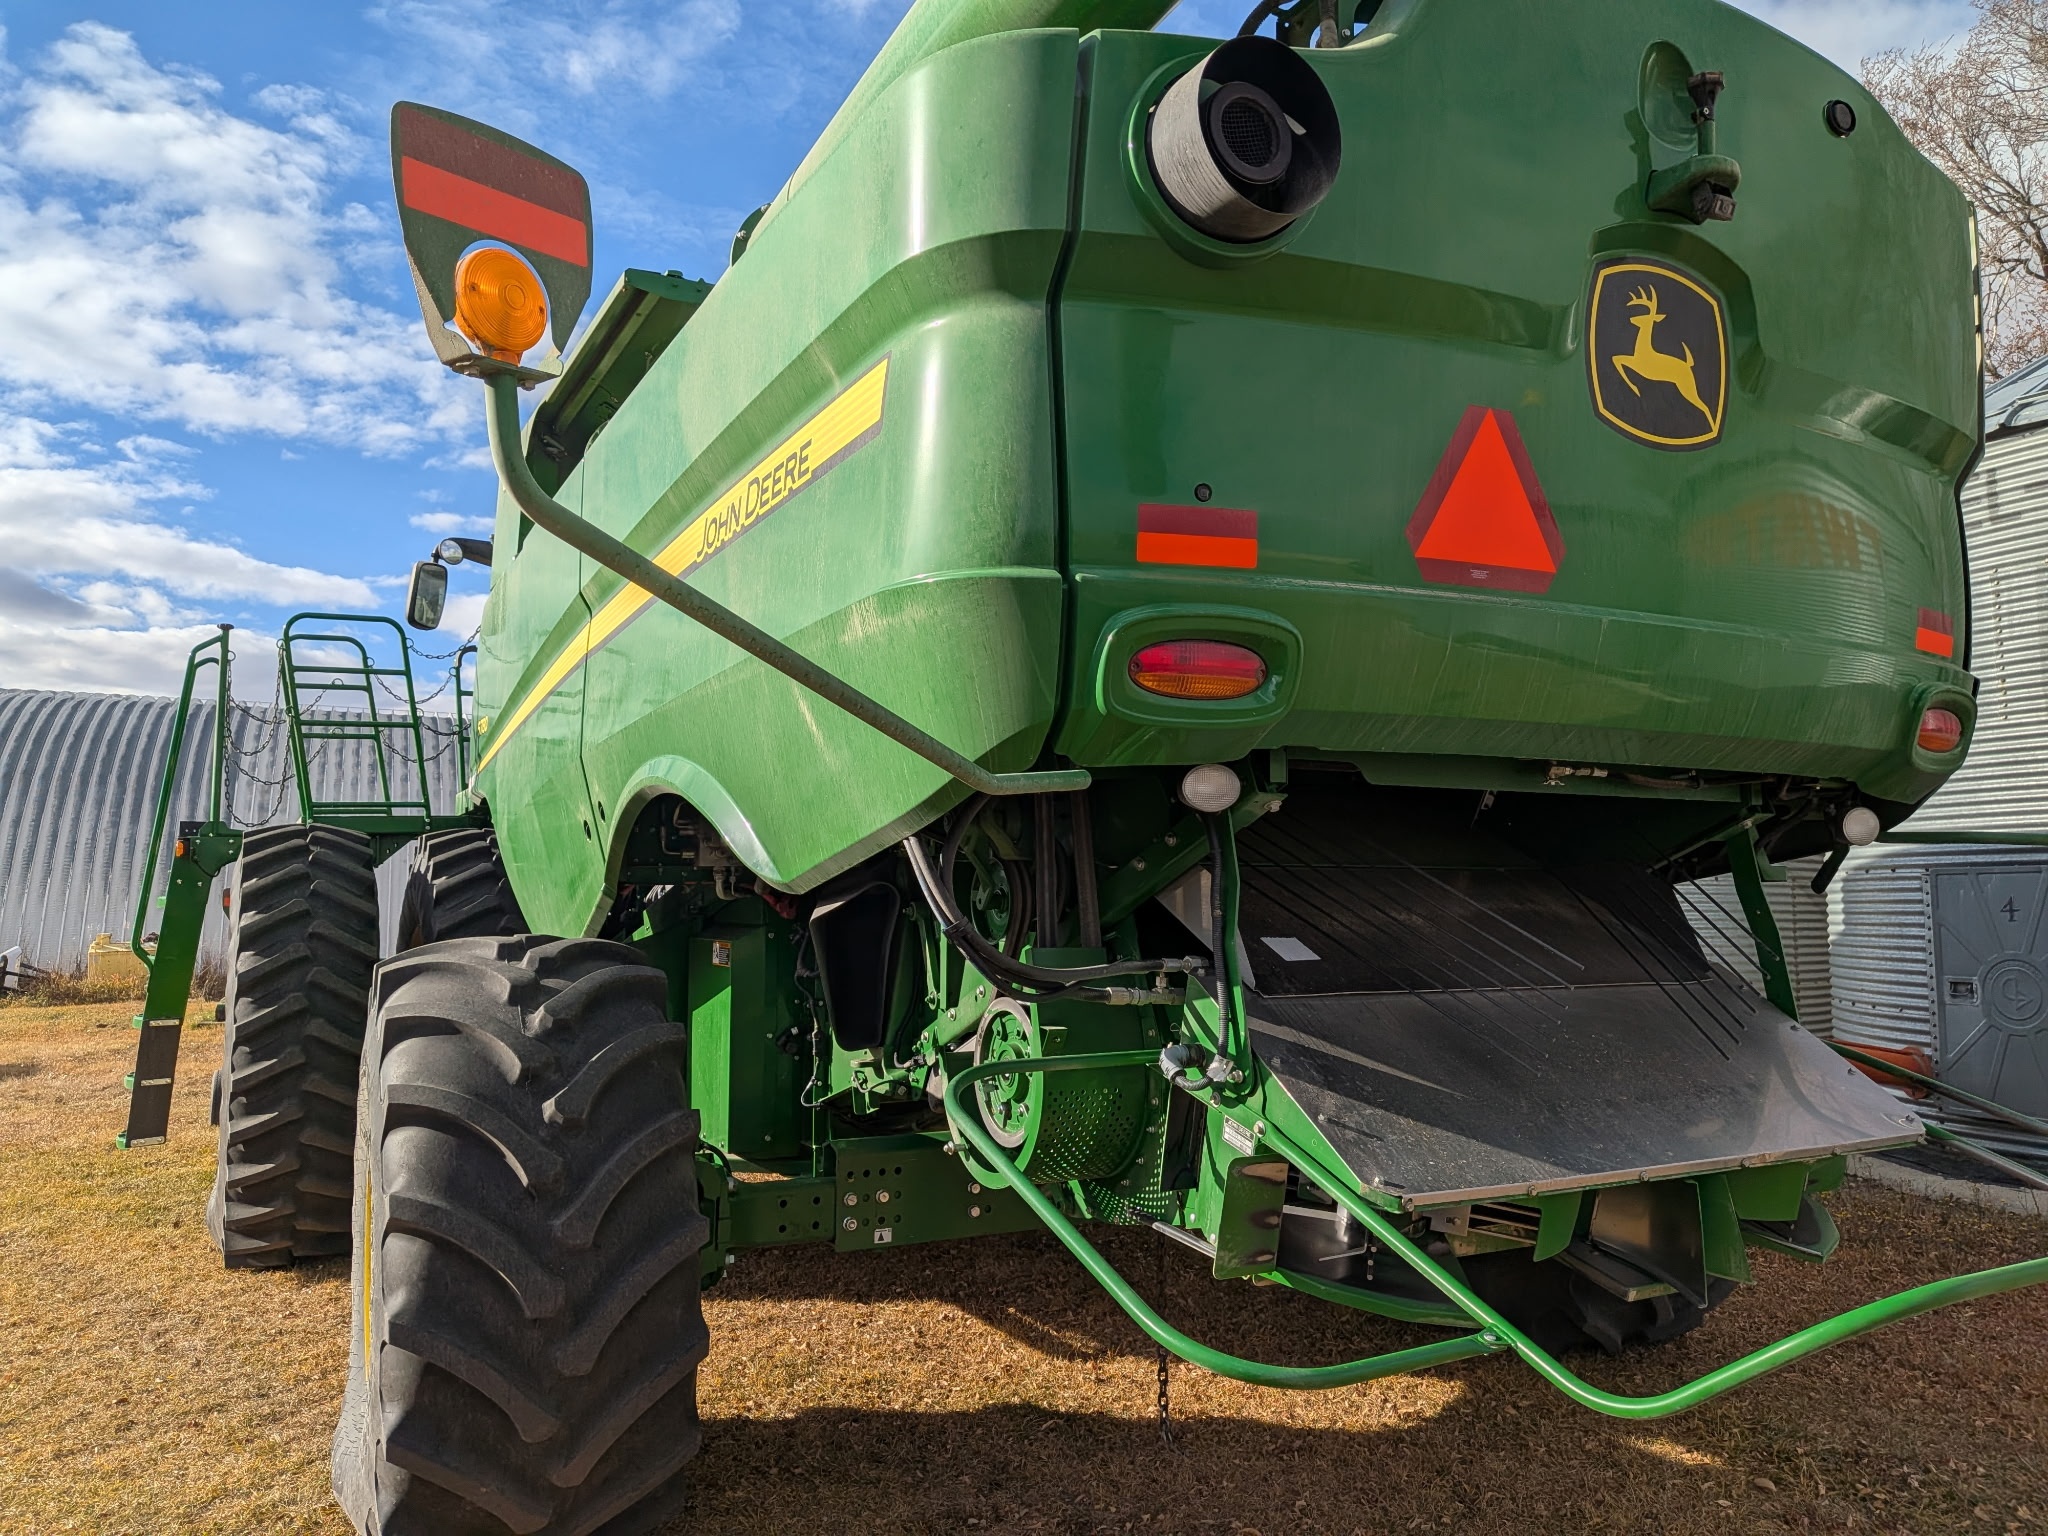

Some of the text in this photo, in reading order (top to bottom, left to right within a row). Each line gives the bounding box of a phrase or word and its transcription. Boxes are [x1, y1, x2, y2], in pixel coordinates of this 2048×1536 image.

[697, 438, 812, 558] JOHN DEERE
[2000, 896, 2021, 922] 4
